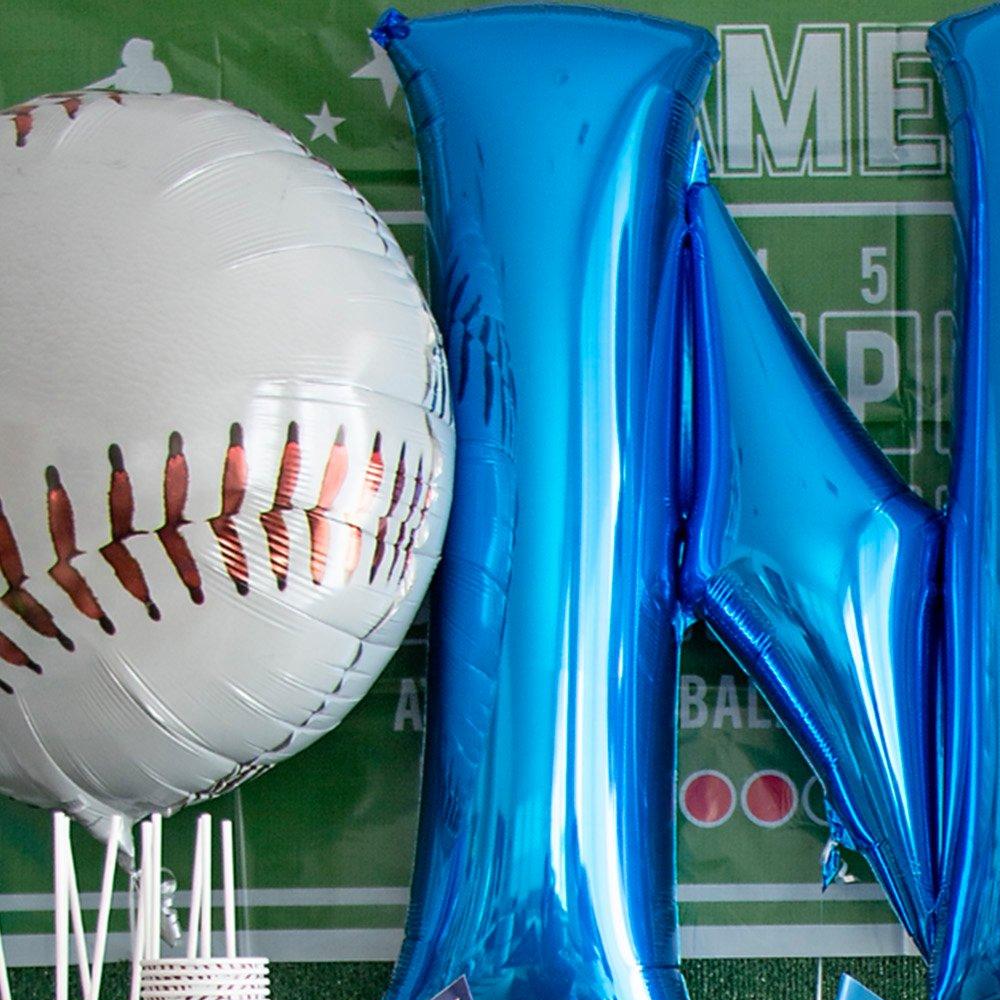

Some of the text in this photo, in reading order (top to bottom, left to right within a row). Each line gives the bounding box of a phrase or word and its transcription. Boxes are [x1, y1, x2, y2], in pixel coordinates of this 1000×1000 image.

[697, 22, 946, 178] ME
[861, 246, 888, 305] 5
[845, 329, 899, 422] P
